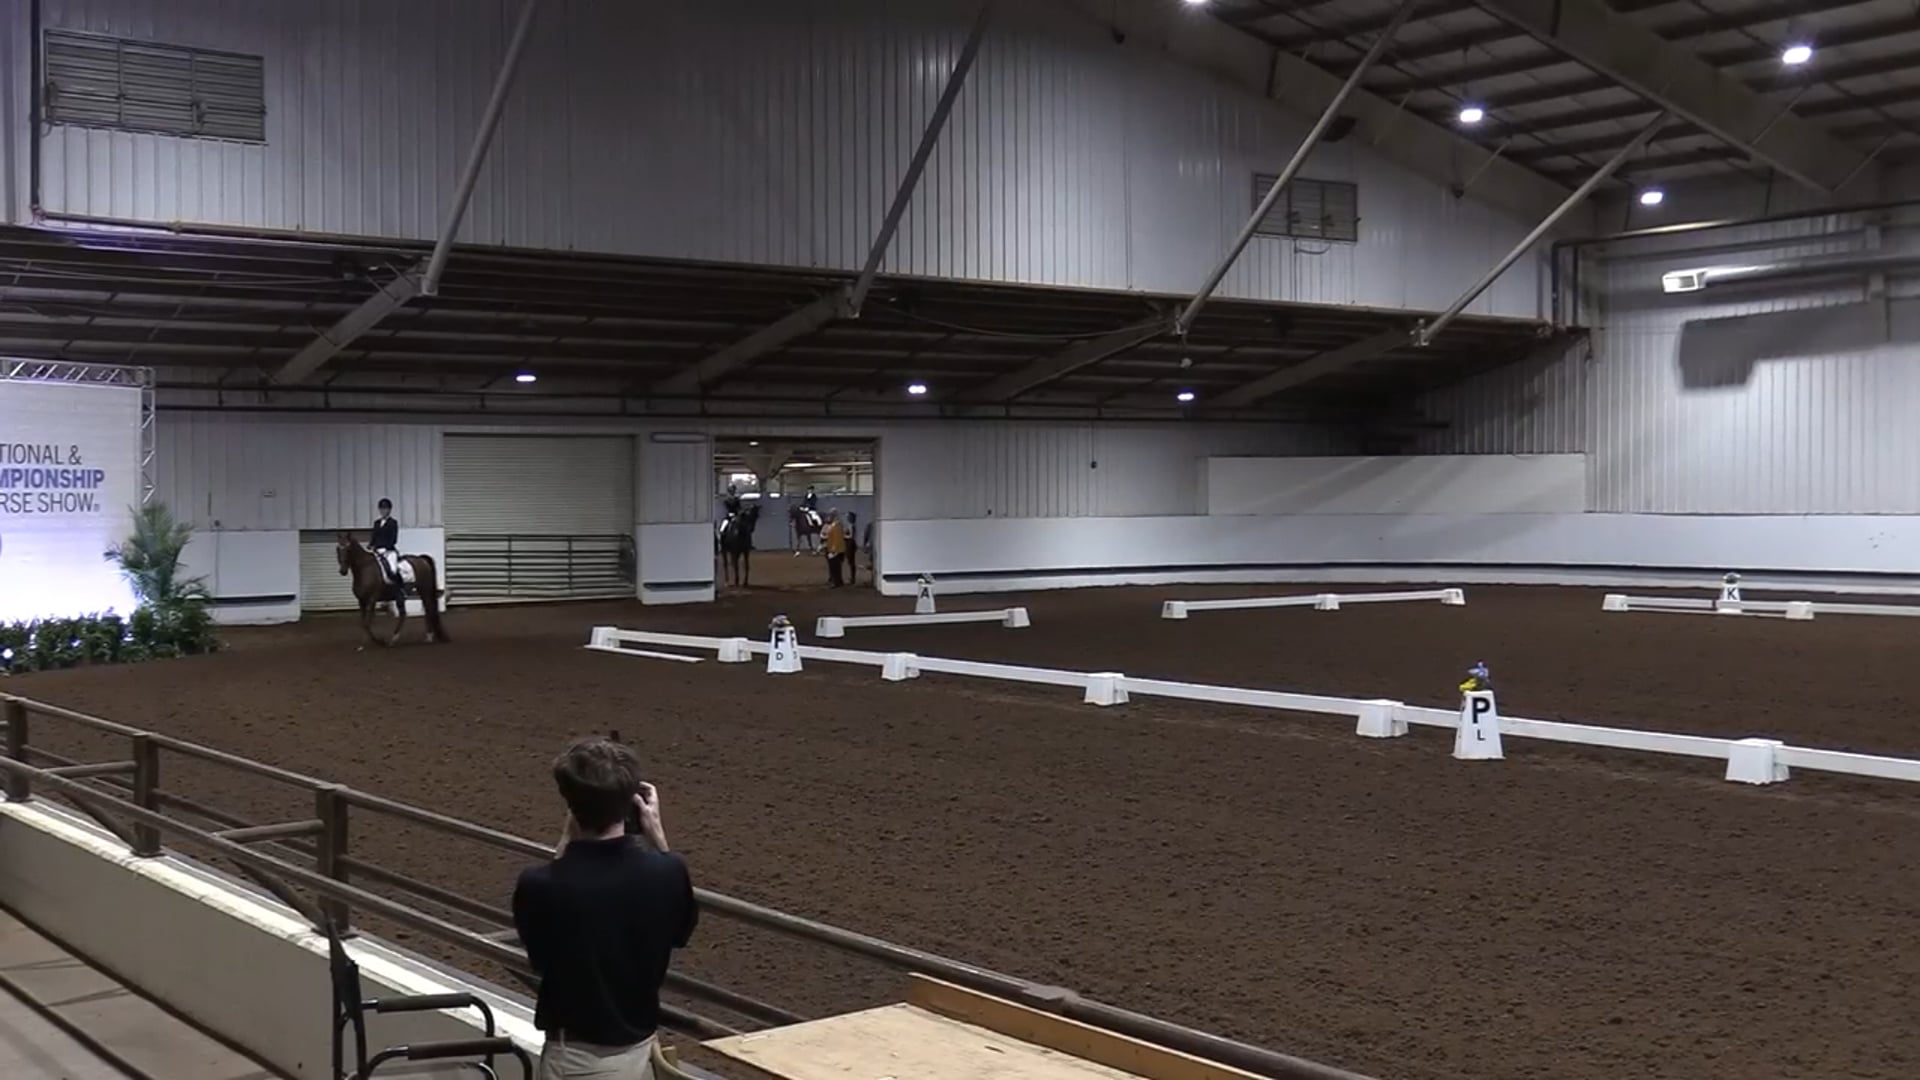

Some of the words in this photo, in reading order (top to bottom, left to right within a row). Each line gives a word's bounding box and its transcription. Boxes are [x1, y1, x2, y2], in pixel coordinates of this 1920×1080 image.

[68, 444, 82, 465] &
[920, 587, 930, 599] A
[1727, 587, 1738, 600] K
[775, 630, 785, 649] F
[776, 652, 784, 661] D
[1472, 697, 1490, 724] P
[1477, 729, 1486, 741] L
